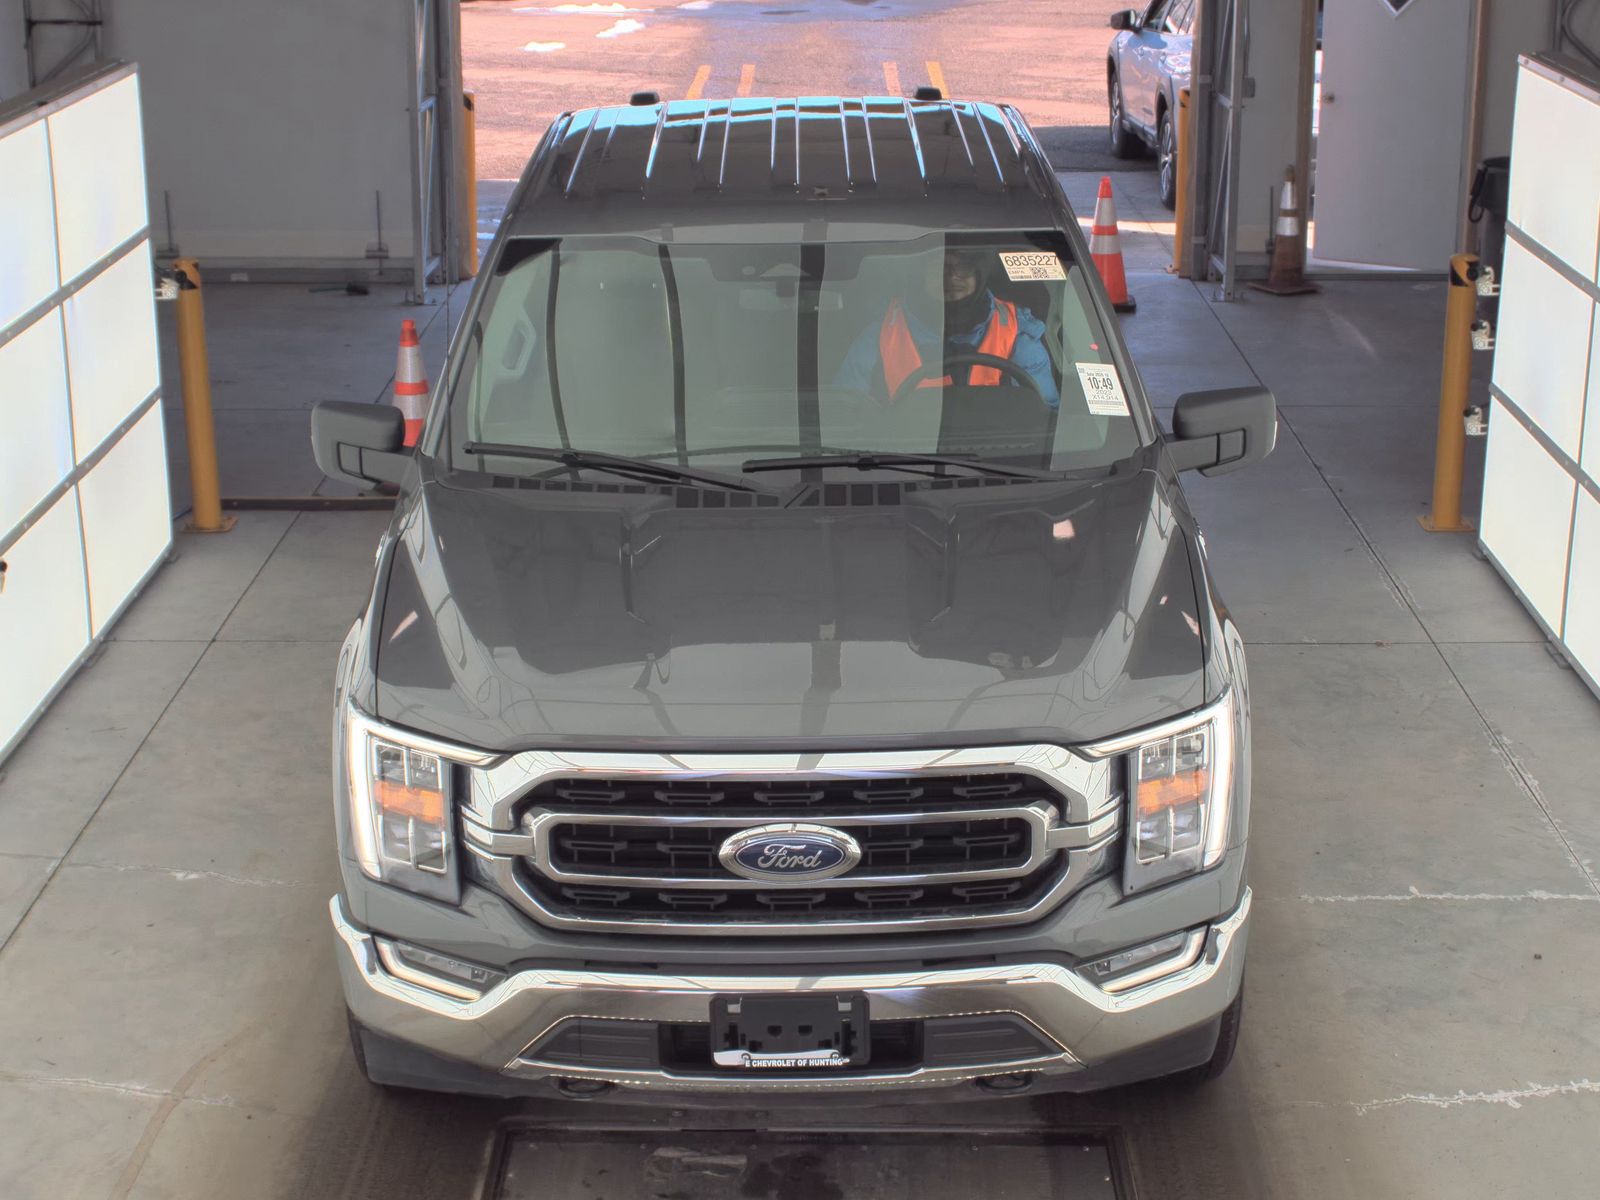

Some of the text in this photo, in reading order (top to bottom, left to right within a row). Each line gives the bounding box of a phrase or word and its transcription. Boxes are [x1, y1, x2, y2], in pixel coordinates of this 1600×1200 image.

[1004, 255, 1057, 266] 6835227
[1088, 377, 1113, 390] 10:49
[757, 843, 822, 868] Ford
[752, 1059, 795, 1067] CHEVROLET
[809, 1058, 843, 1066] HUNTING
